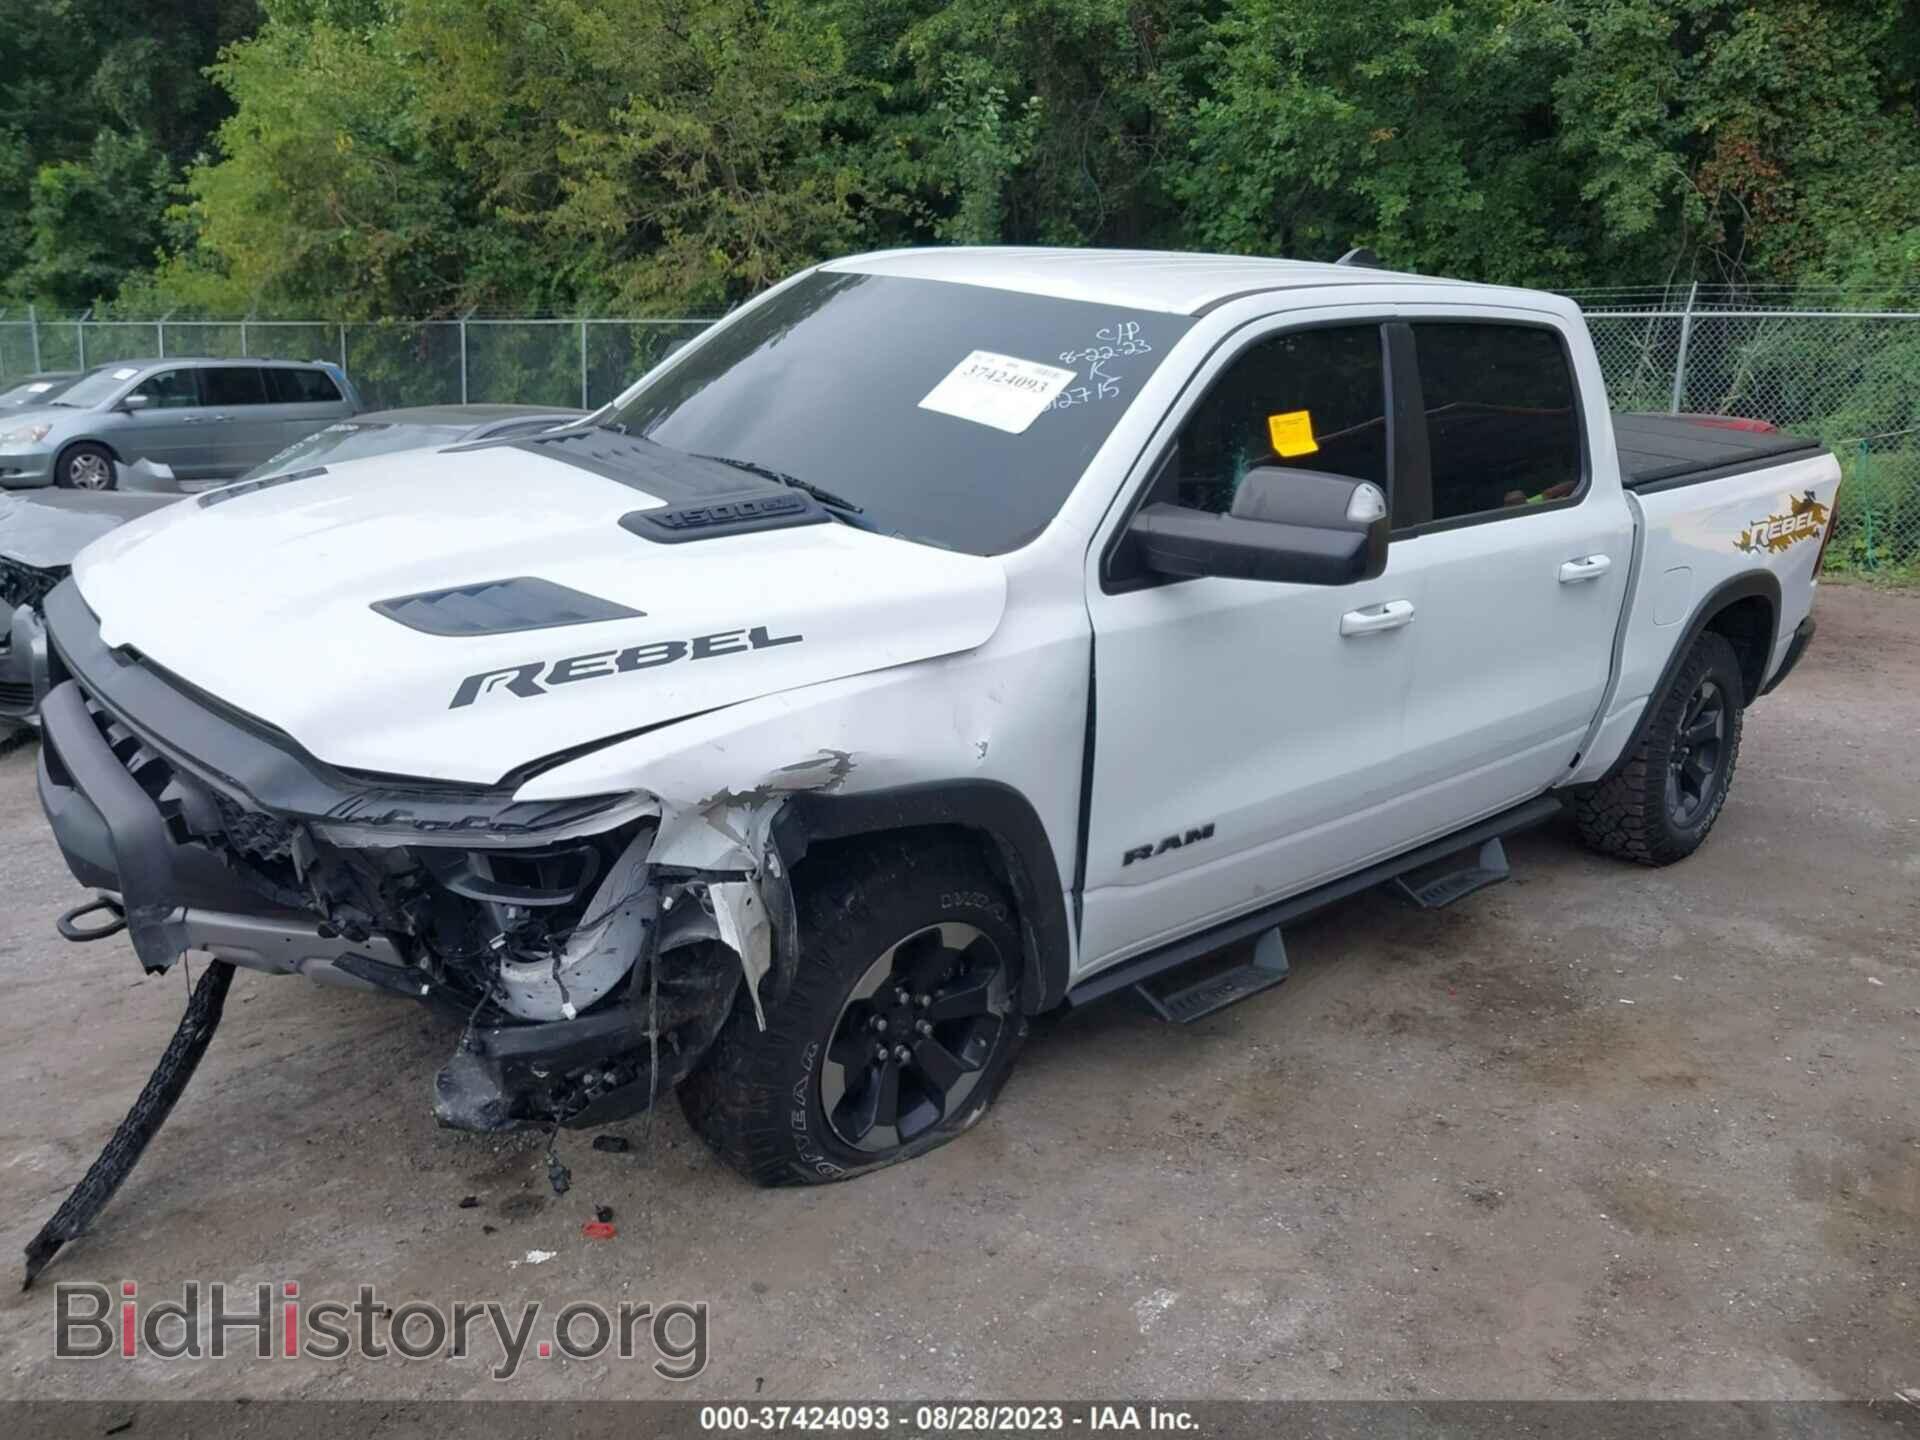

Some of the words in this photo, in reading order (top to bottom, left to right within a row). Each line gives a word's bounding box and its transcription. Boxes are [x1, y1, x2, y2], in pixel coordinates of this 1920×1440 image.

[962, 363, 1049, 393] 37424093
[1749, 511, 1817, 548] REBEL
[448, 626, 803, 710] REBEL
[1122, 822, 1215, 866] RAM
